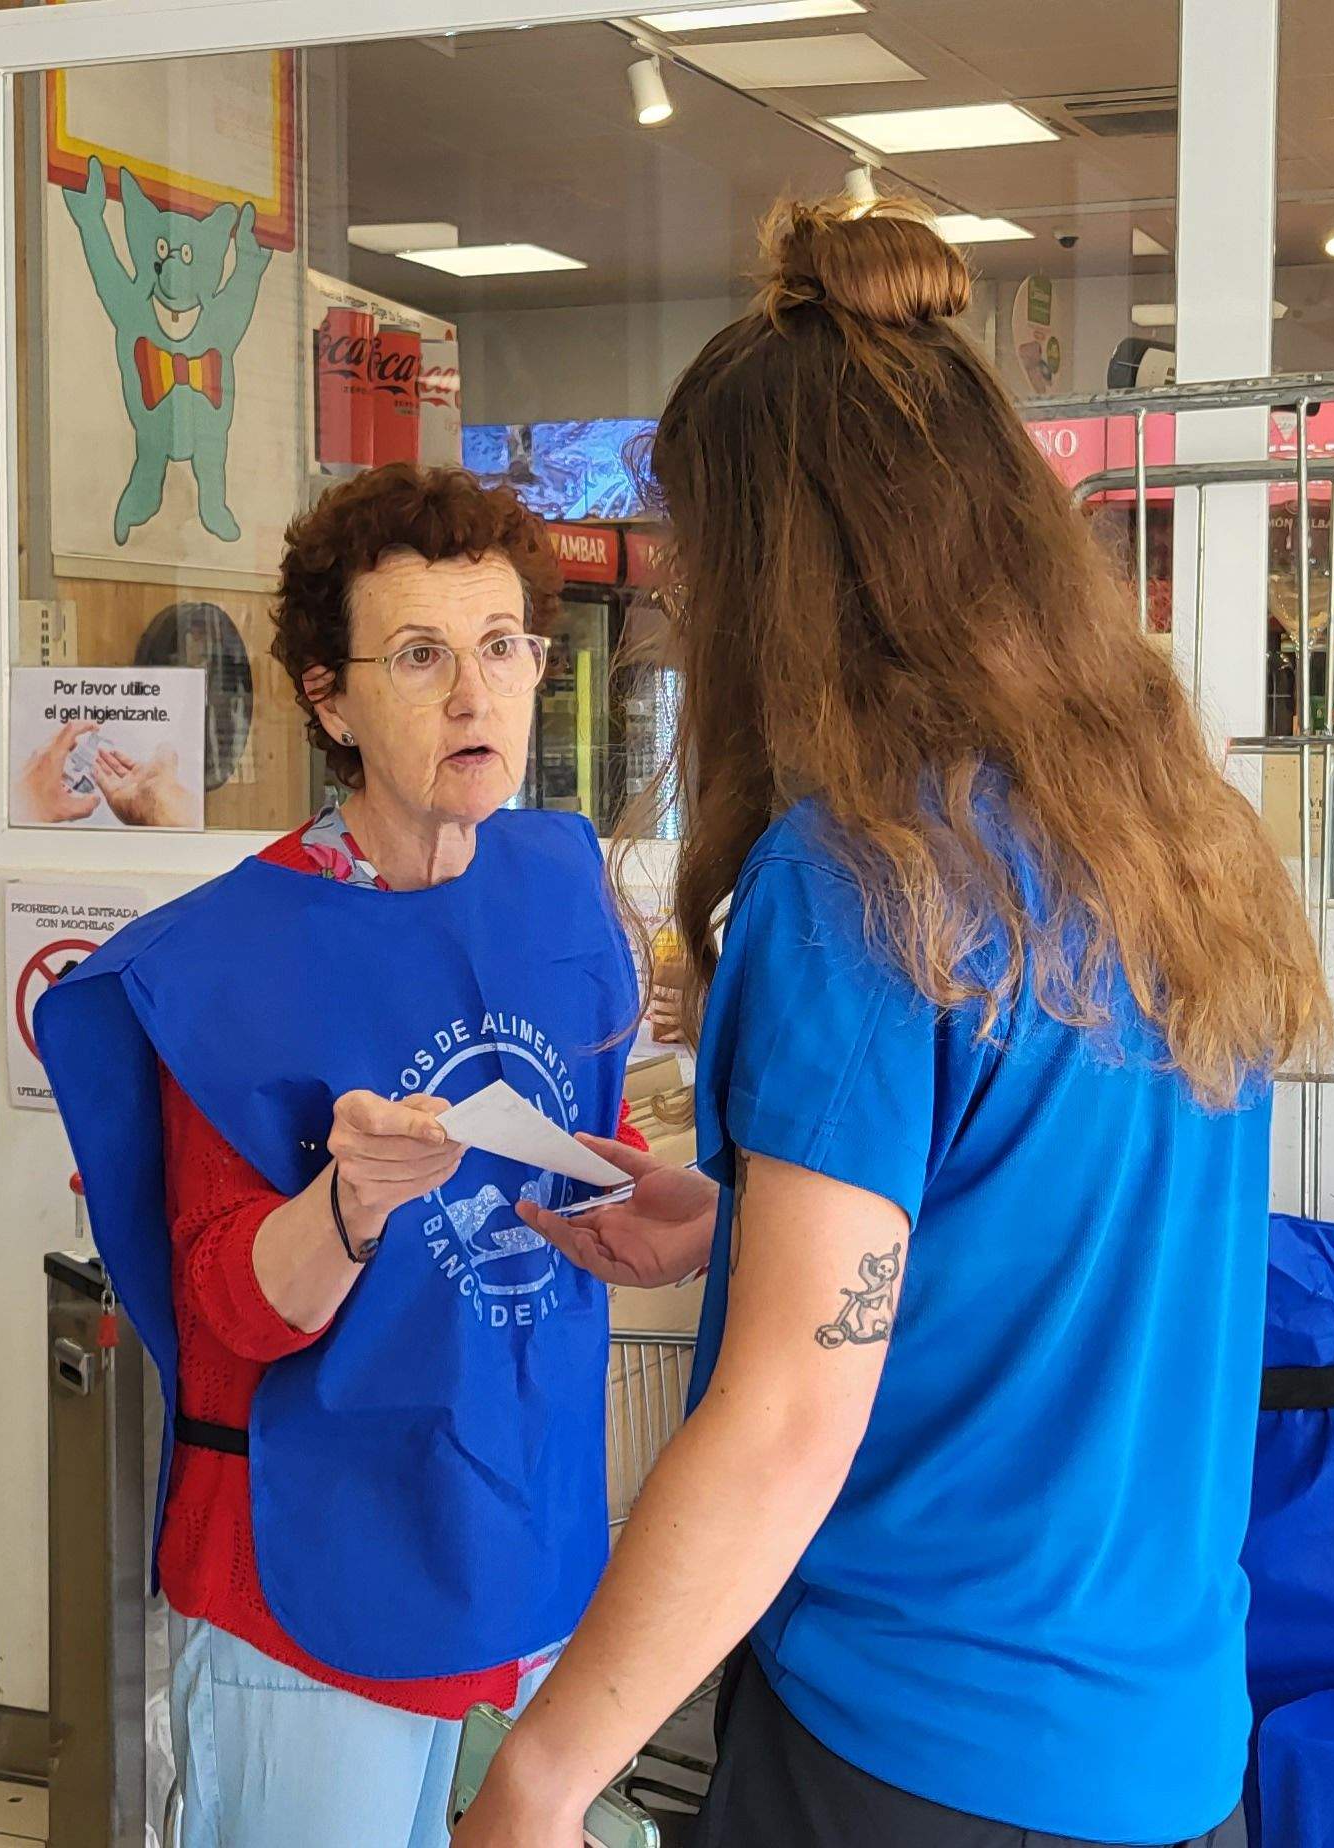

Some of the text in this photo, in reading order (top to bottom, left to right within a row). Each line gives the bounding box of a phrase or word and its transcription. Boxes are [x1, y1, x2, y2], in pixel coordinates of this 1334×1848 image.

[560, 535, 608, 565] AMBAR
[53, 680, 161, 697] Por favor utilice
[44, 704, 170, 724] el gel higienizante.
[11, 902, 139, 919] PROHIBIDA LA ENTRADA
[35, 917, 115, 932] CON MOCHILAS
[433, 1018, 470, 1054] DE
[480, 1011, 579, 1123] ALIMENTOS
[490, 1304, 533, 1328] DE
